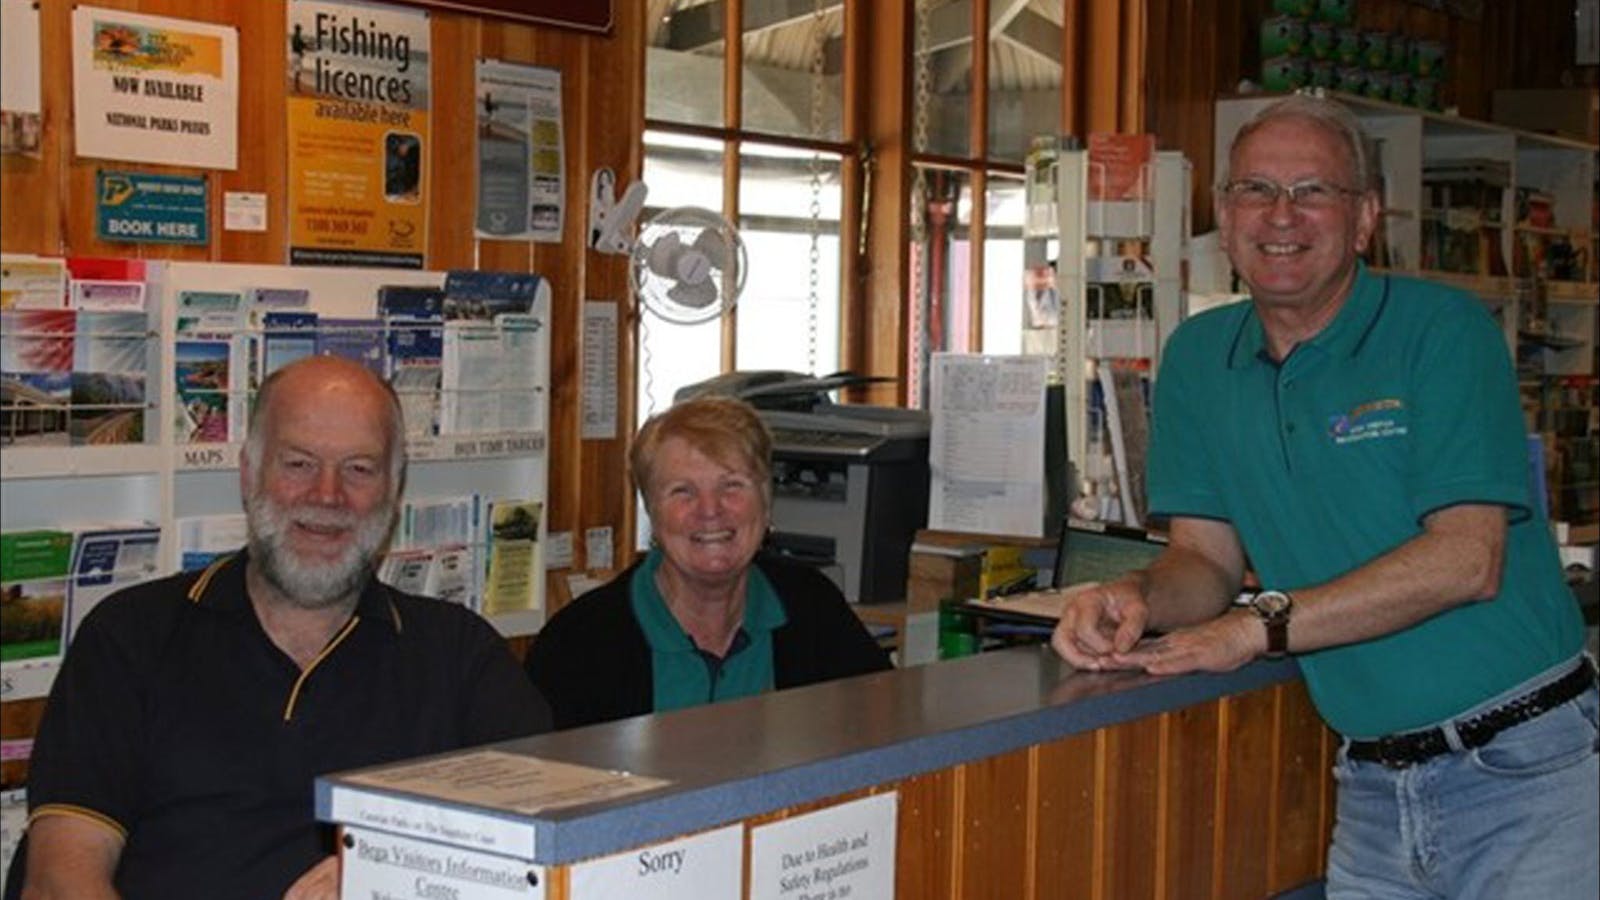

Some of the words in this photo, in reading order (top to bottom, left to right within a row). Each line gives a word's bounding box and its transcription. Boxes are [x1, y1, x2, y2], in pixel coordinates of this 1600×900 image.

[316, 13, 409, 73] Fishing
[113, 76, 139, 95] NOW
[144, 79, 204, 103] AVAILABLE
[316, 57, 411, 104] licences
[315, 100, 378, 123] available
[380, 104, 411, 128] here
[108, 218, 153, 236] BOOK
[157, 221, 199, 238] HERE
[184, 450, 224, 466] MAPS
[638, 849, 686, 877] Sorry
[782, 852, 803, 870] Due
[817, 837, 849, 860] Health
[850, 830, 869, 851] and
[443, 856, 529, 892] Information
[780, 873, 811, 896] Safety
[813, 857, 869, 885] Regulations
